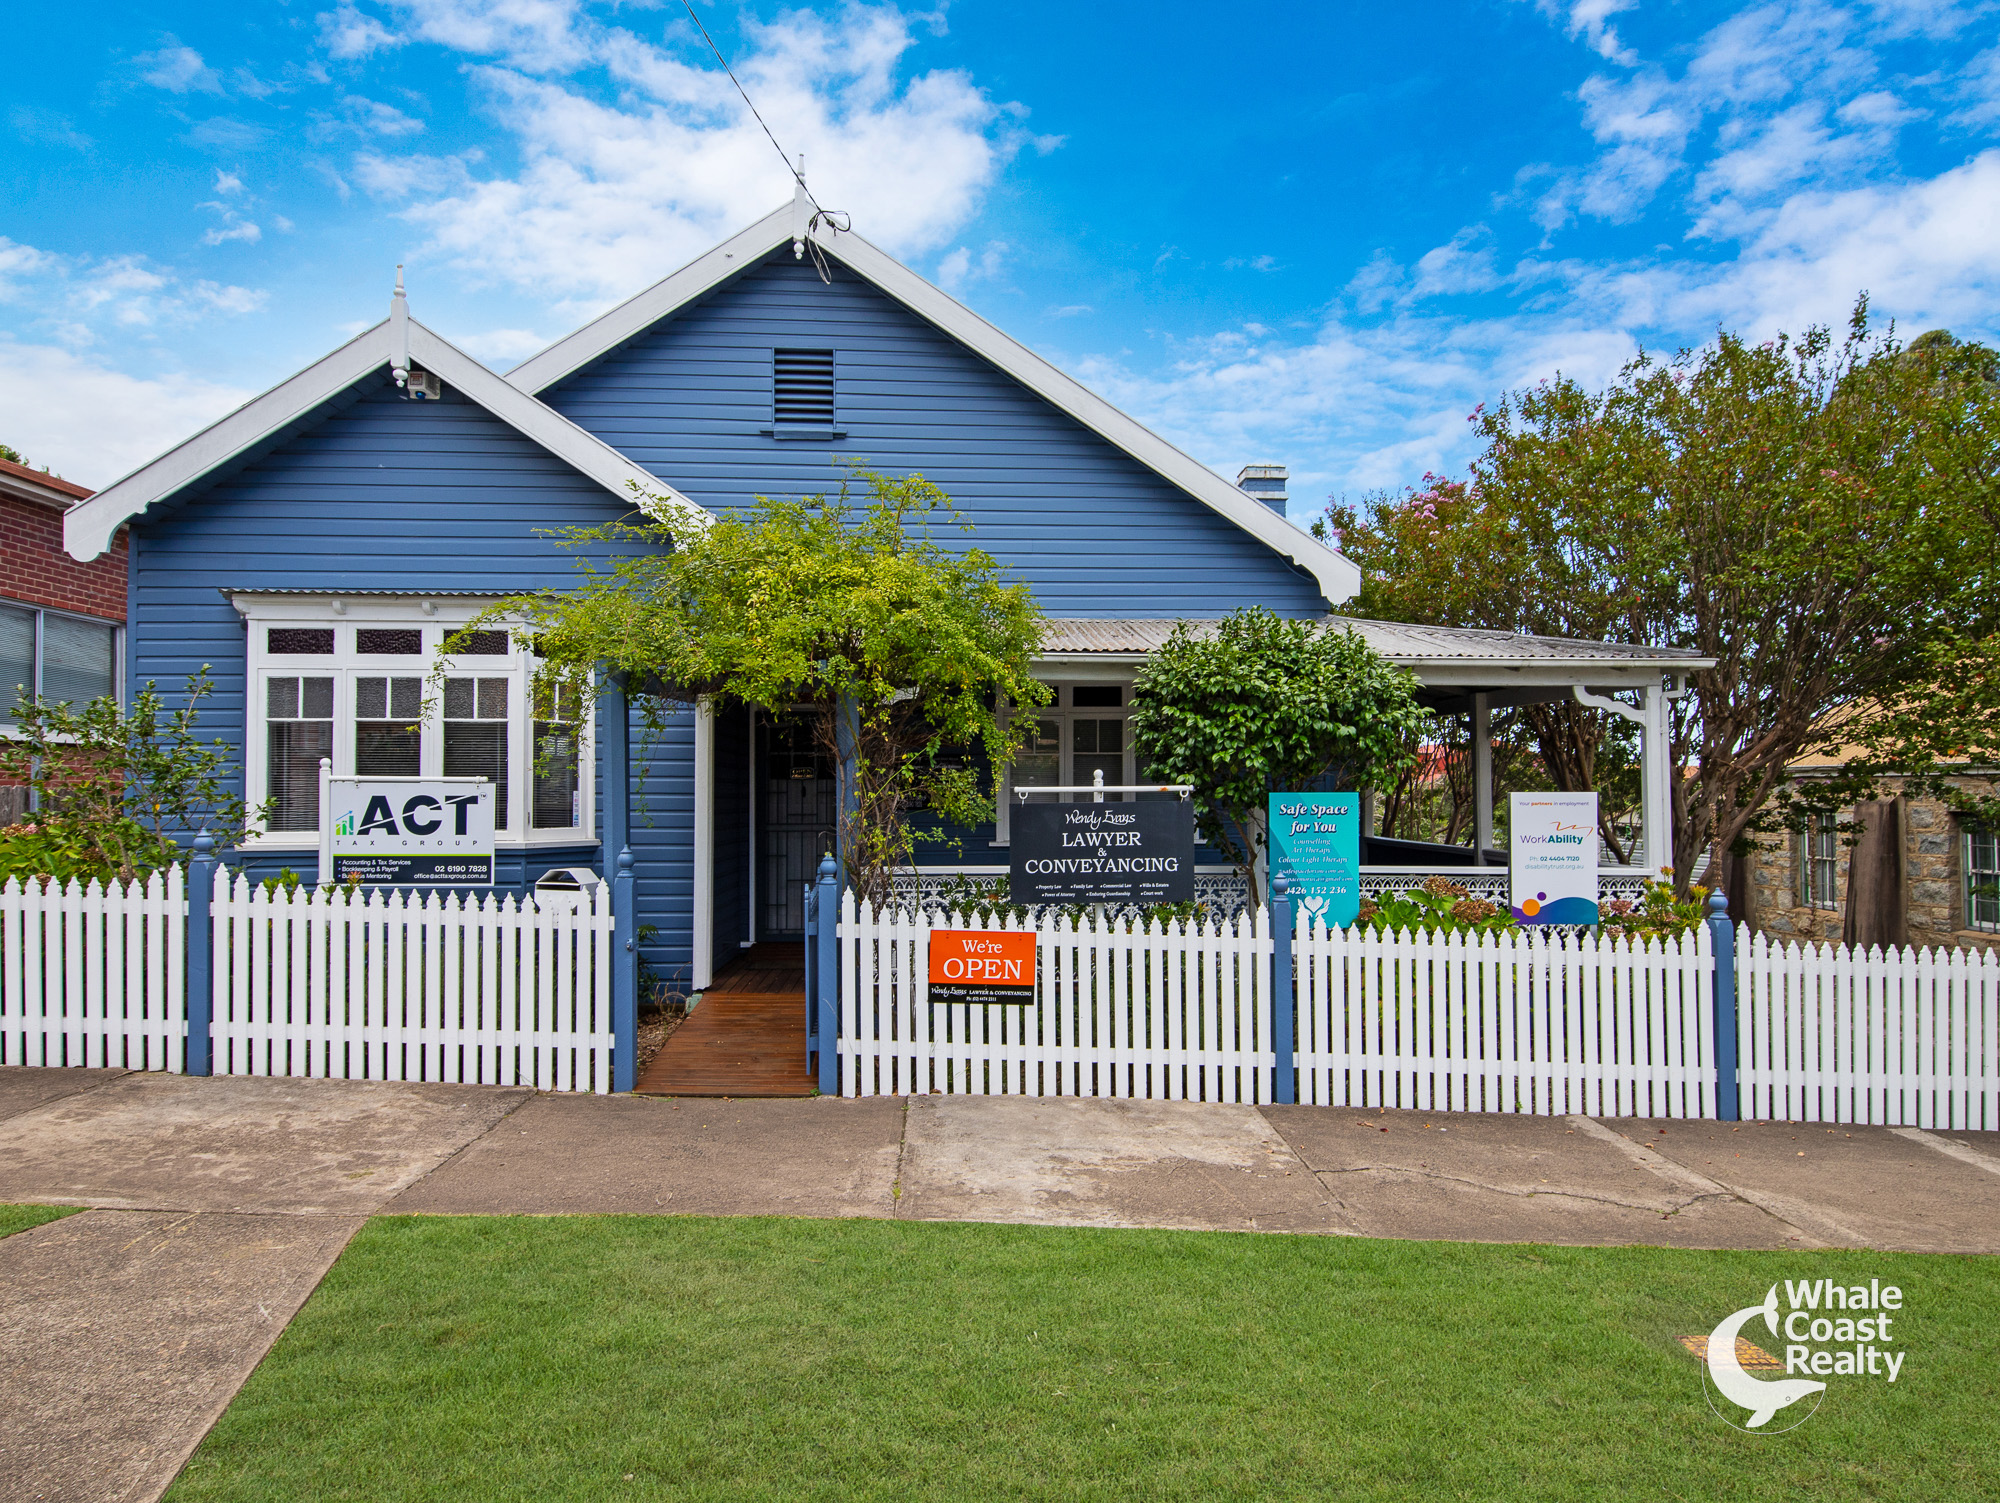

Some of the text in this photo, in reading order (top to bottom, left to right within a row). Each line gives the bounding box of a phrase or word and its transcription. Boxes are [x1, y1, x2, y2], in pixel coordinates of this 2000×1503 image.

[356, 794, 479, 836] ACT
[1279, 803, 1348, 818] Safe Space
[1065, 809, 1136, 830] Wendy Evans
[1289, 821, 1337, 836] for You
[1062, 831, 1142, 847] LAWYER
[1293, 838, 1331, 846] Counselling
[1520, 834, 1584, 845] WorkAbility
[1097, 847, 1107, 856] &
[1025, 857, 1179, 874] CONVEYANCING
[1278, 856, 1348, 864] Colour Light Therapy
[1310, 886, 1327, 894] 152
[1329, 886, 1347, 894] 236
[962, 939, 1003, 954] We're
[943, 957, 1023, 980] OPEN
[931, 985, 950, 997] Wendy
[950, 986, 967, 996] Evans
